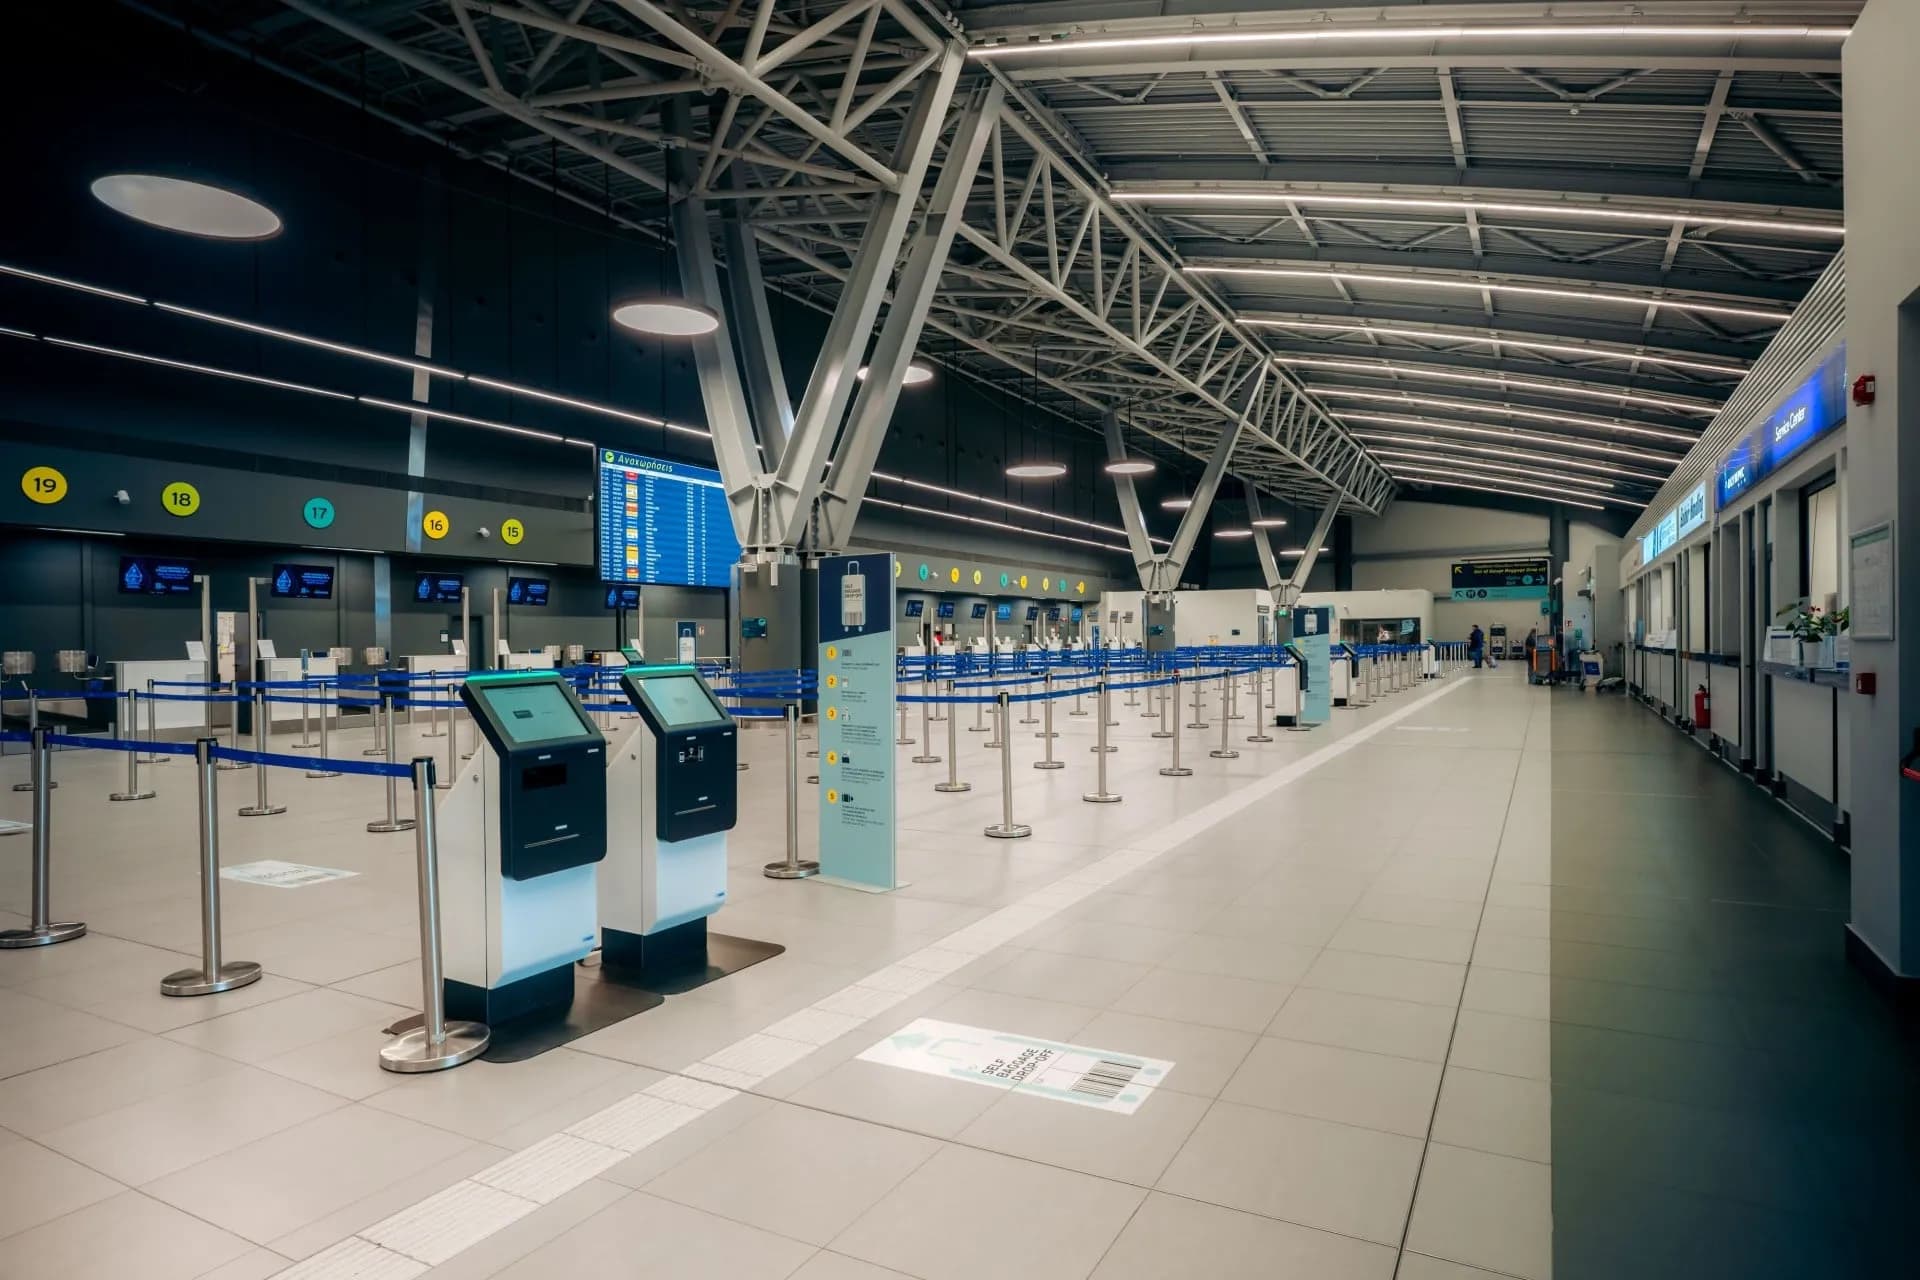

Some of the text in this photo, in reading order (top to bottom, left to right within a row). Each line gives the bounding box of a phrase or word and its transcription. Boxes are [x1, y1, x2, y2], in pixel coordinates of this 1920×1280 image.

[617, 454, 673, 473] Αναχωρήσεις
[33, 477, 57, 493] 19
[171, 492, 191, 507] 18
[311, 506, 327, 520] 17
[430, 519, 443, 531] 16
[507, 526, 519, 538] 15
[981, 1058, 1005, 1075] SELF
[996, 1047, 1039, 1078] BAGGAGE
[1011, 1048, 1055, 1082] DROP-OFF
